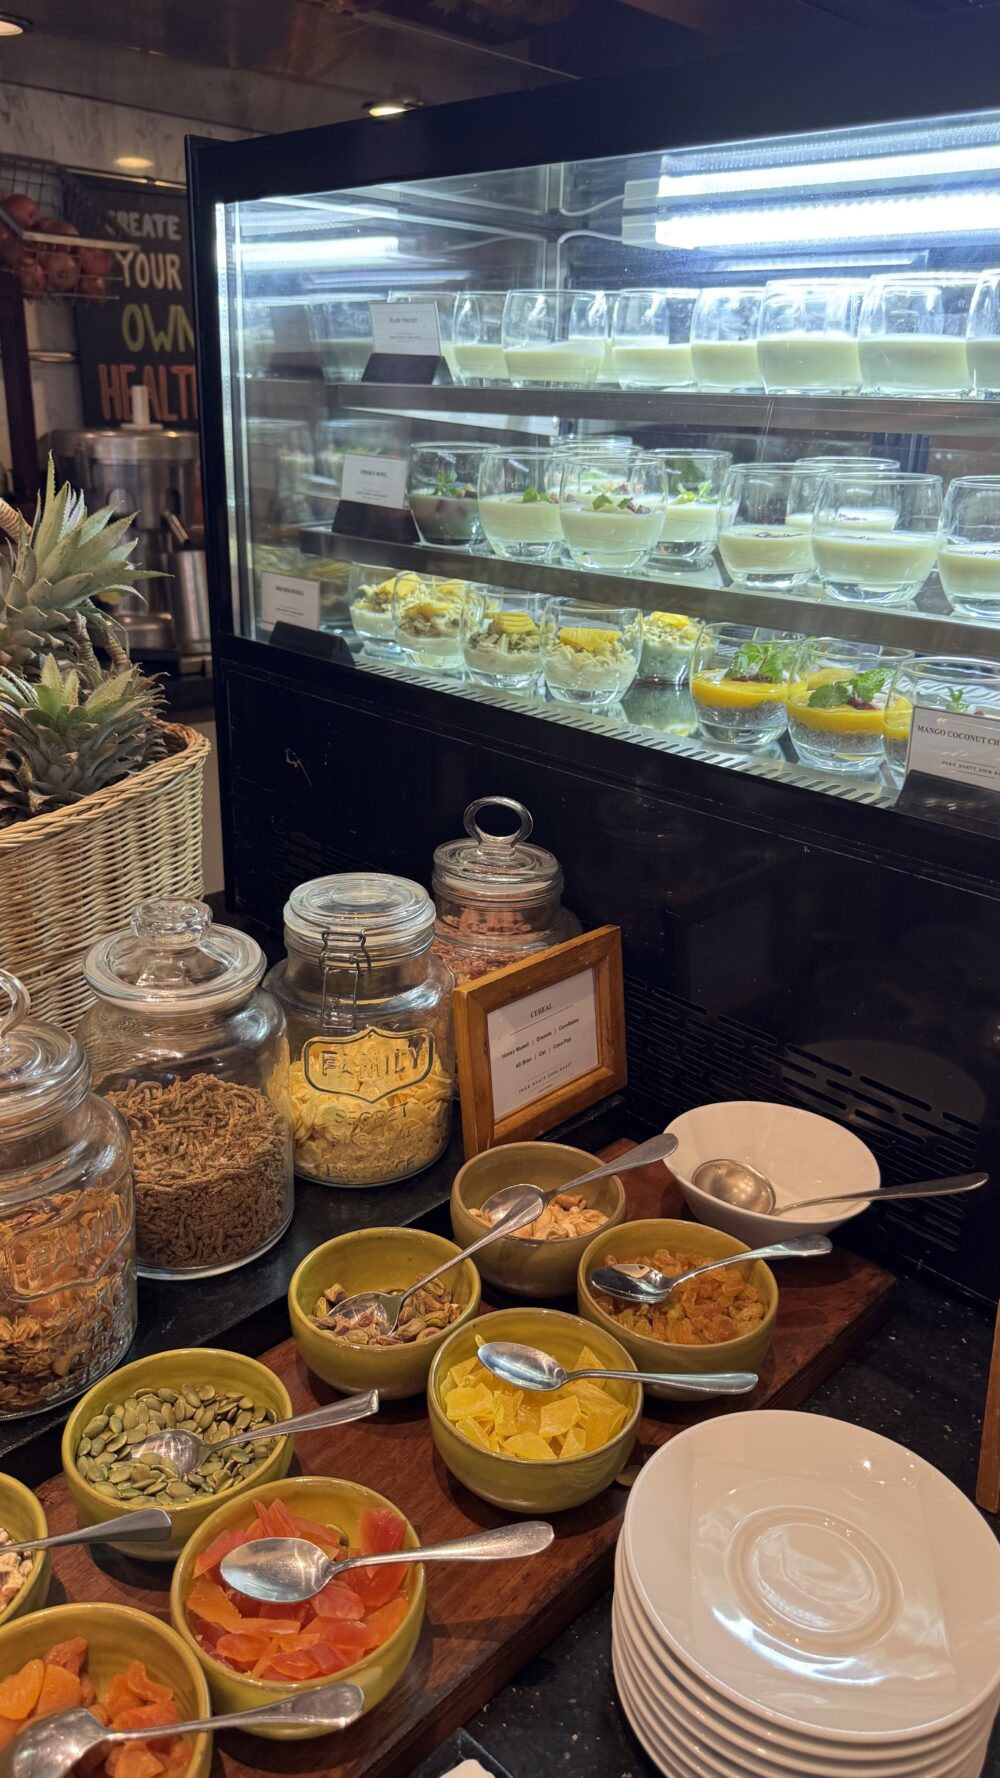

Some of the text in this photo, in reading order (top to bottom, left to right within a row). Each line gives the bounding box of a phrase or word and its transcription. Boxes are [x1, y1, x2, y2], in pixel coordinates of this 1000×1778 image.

[114, 250, 183, 291] YOUR
[121, 303, 195, 352] OWN
[917, 725, 946, 736] MANGO
[947, 730, 986, 744] COCONUT
[530, 1003, 553, 1018] CEREAL
[501, 1049, 516, 1059] Honey
[558, 1018, 579, 1031] Cornflakes
[538, 1049, 547, 1057] Oat
[553, 1041, 564, 1049] Coco
[563, 1037, 572, 1045] Pop
[321, 1046, 424, 1077] FAMILY
